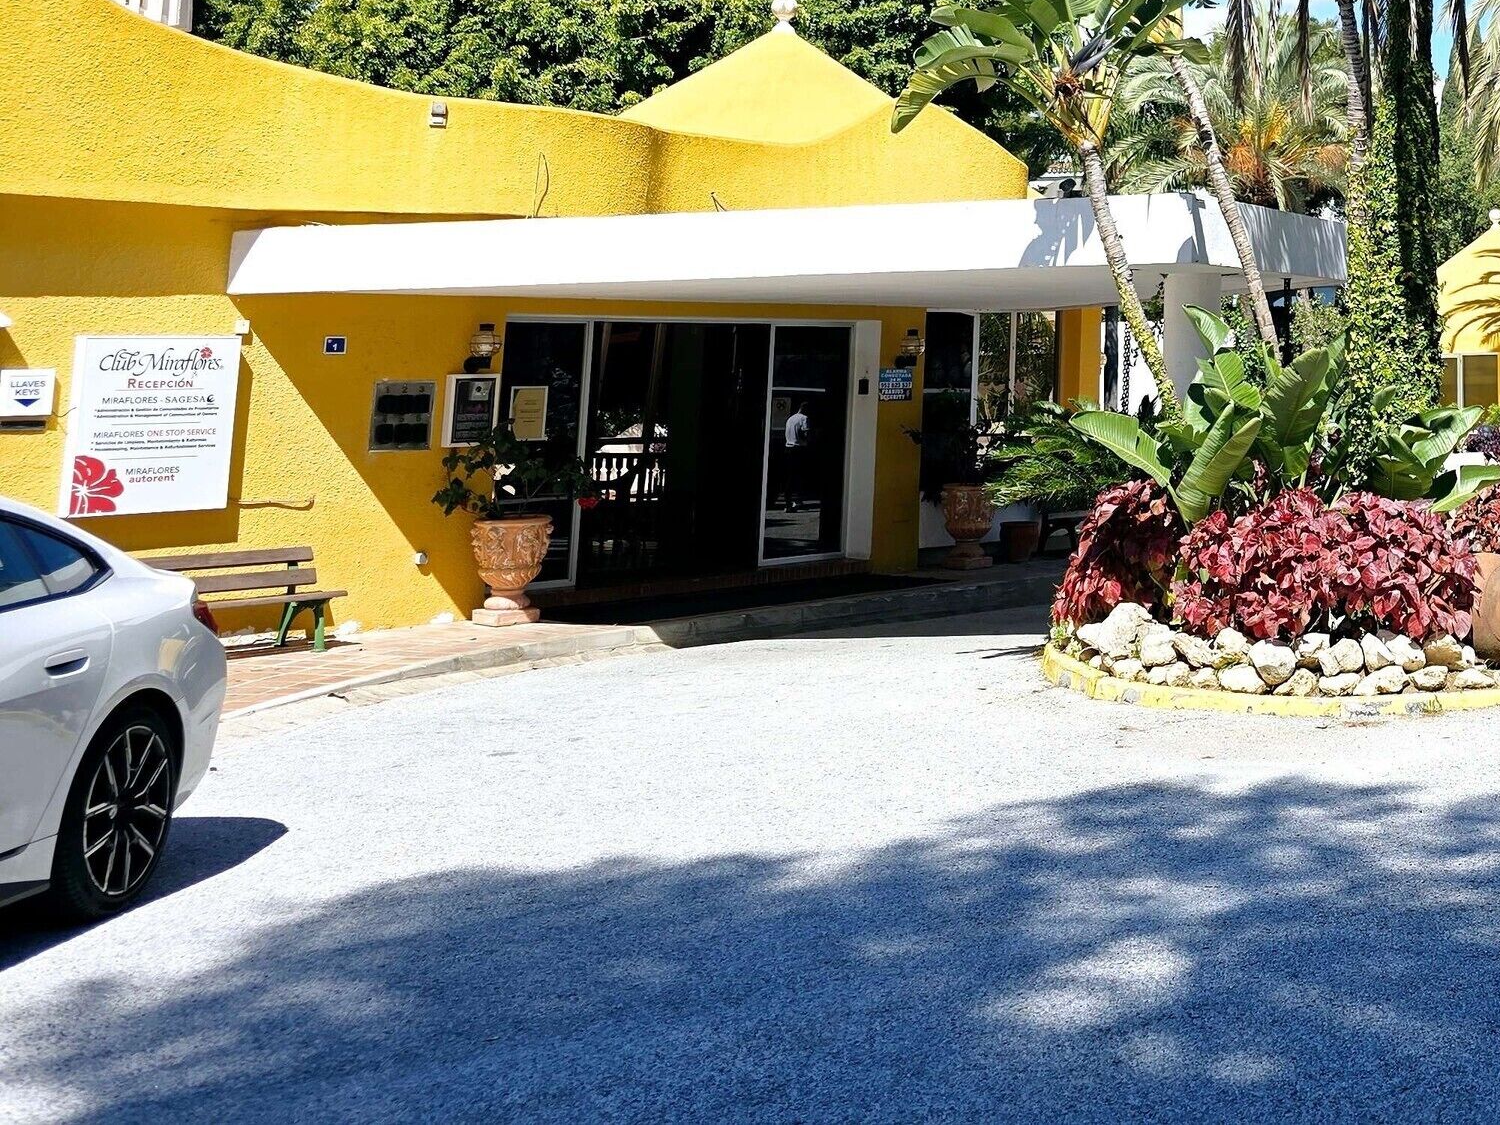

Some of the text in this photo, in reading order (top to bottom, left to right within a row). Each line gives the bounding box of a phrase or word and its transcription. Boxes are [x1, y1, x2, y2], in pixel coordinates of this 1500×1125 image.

[332, 343, 338, 351] 1
[100, 347, 222, 377] Club Miraflores
[10, 380, 47, 388] LLAVES
[127, 378, 194, 389] RECEPCIÓN
[15, 388, 40, 396] KEYS
[402, 386, 408, 394] 2
[419, 386, 426, 394] 3
[102, 396, 158, 405] MIRAFLORES
[165, 396, 206, 404] SAGESA
[93, 427, 217, 438] MIRAFLORES ONE STOP SERVICE
[125, 466, 180, 475] MIRAFLORES
[128, 474, 176, 484] autorent
